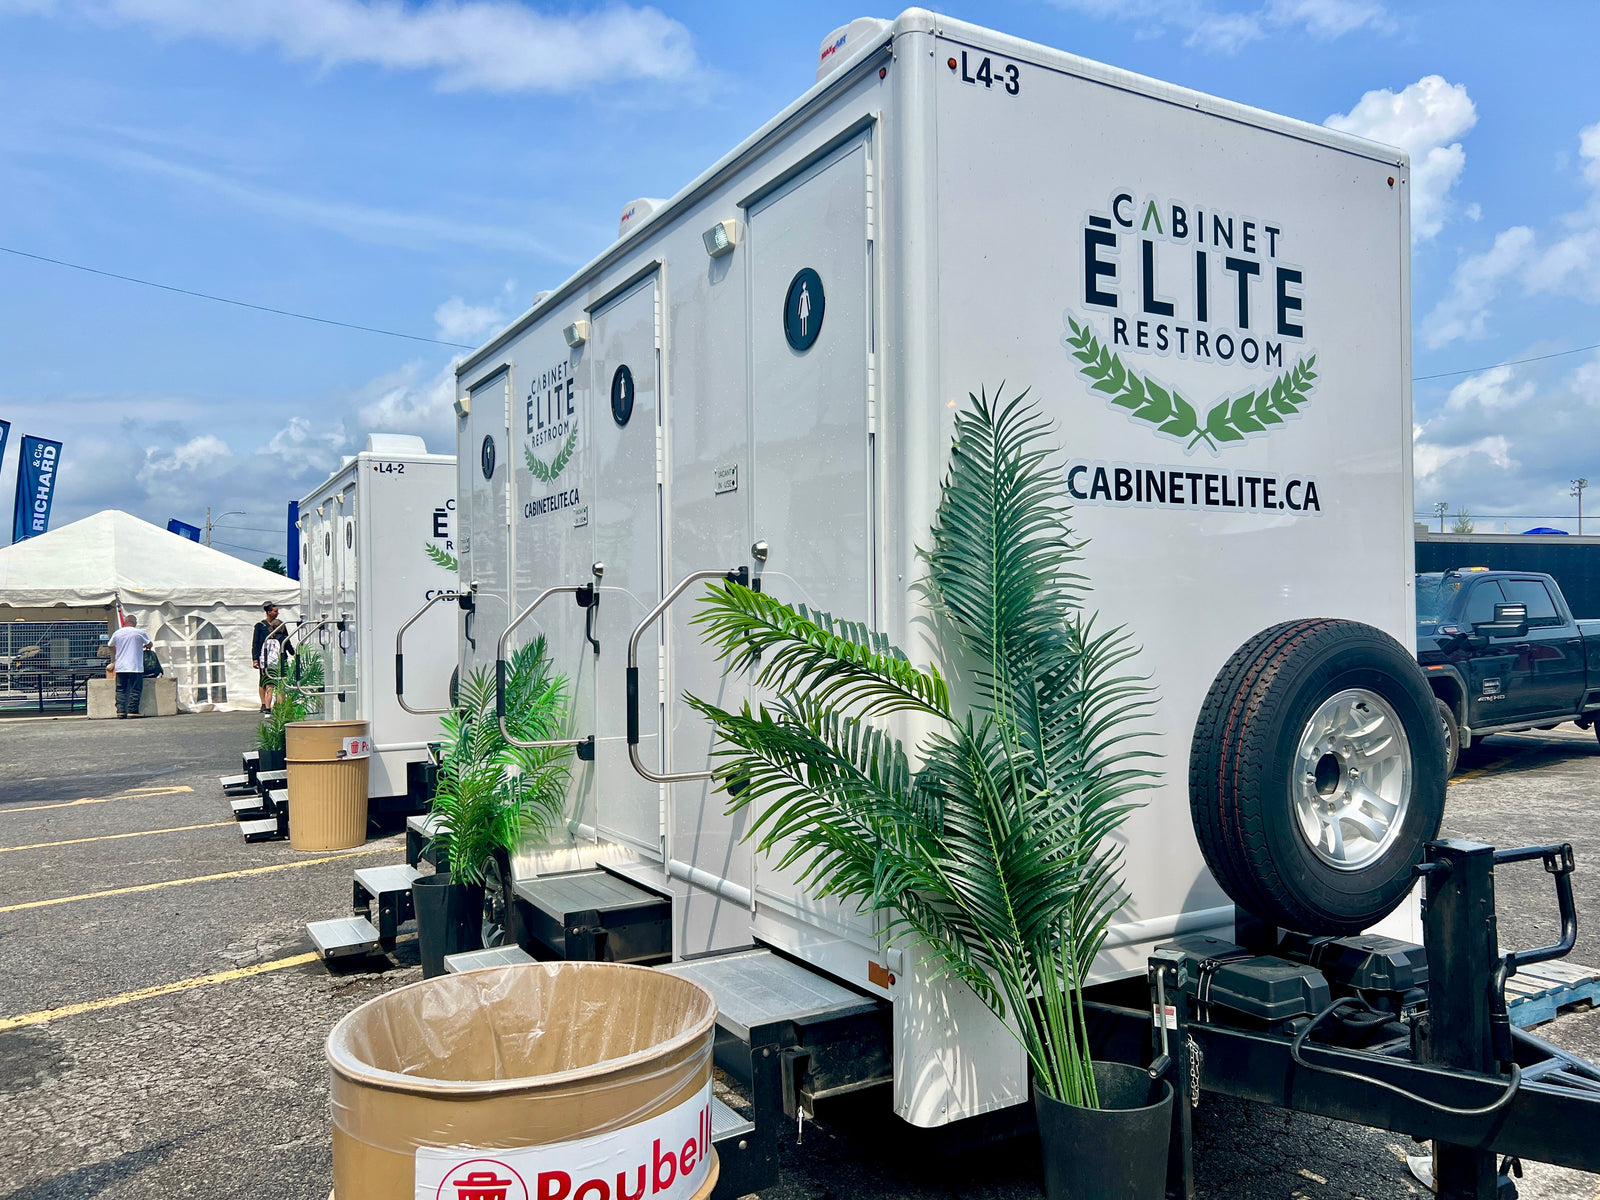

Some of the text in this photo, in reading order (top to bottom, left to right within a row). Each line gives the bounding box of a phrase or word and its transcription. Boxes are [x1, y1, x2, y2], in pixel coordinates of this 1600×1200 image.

[962, 51, 1019, 95] L4-3
[1113, 193, 1280, 258] CABINET
[1113, 317, 1283, 367] RESTROOM
[531, 360, 568, 395] CABINET
[531, 420, 569, 449] RESTROOM
[32, 459, 41, 468] &
[379, 463, 405, 474] L4-2
[32, 445, 56, 531] RICHARD
[524, 488, 580, 519] CABINETELITE.CA
[1067, 465, 1321, 512] CABINETELITE.CA
[537, 1103, 712, 1200] Poubell
